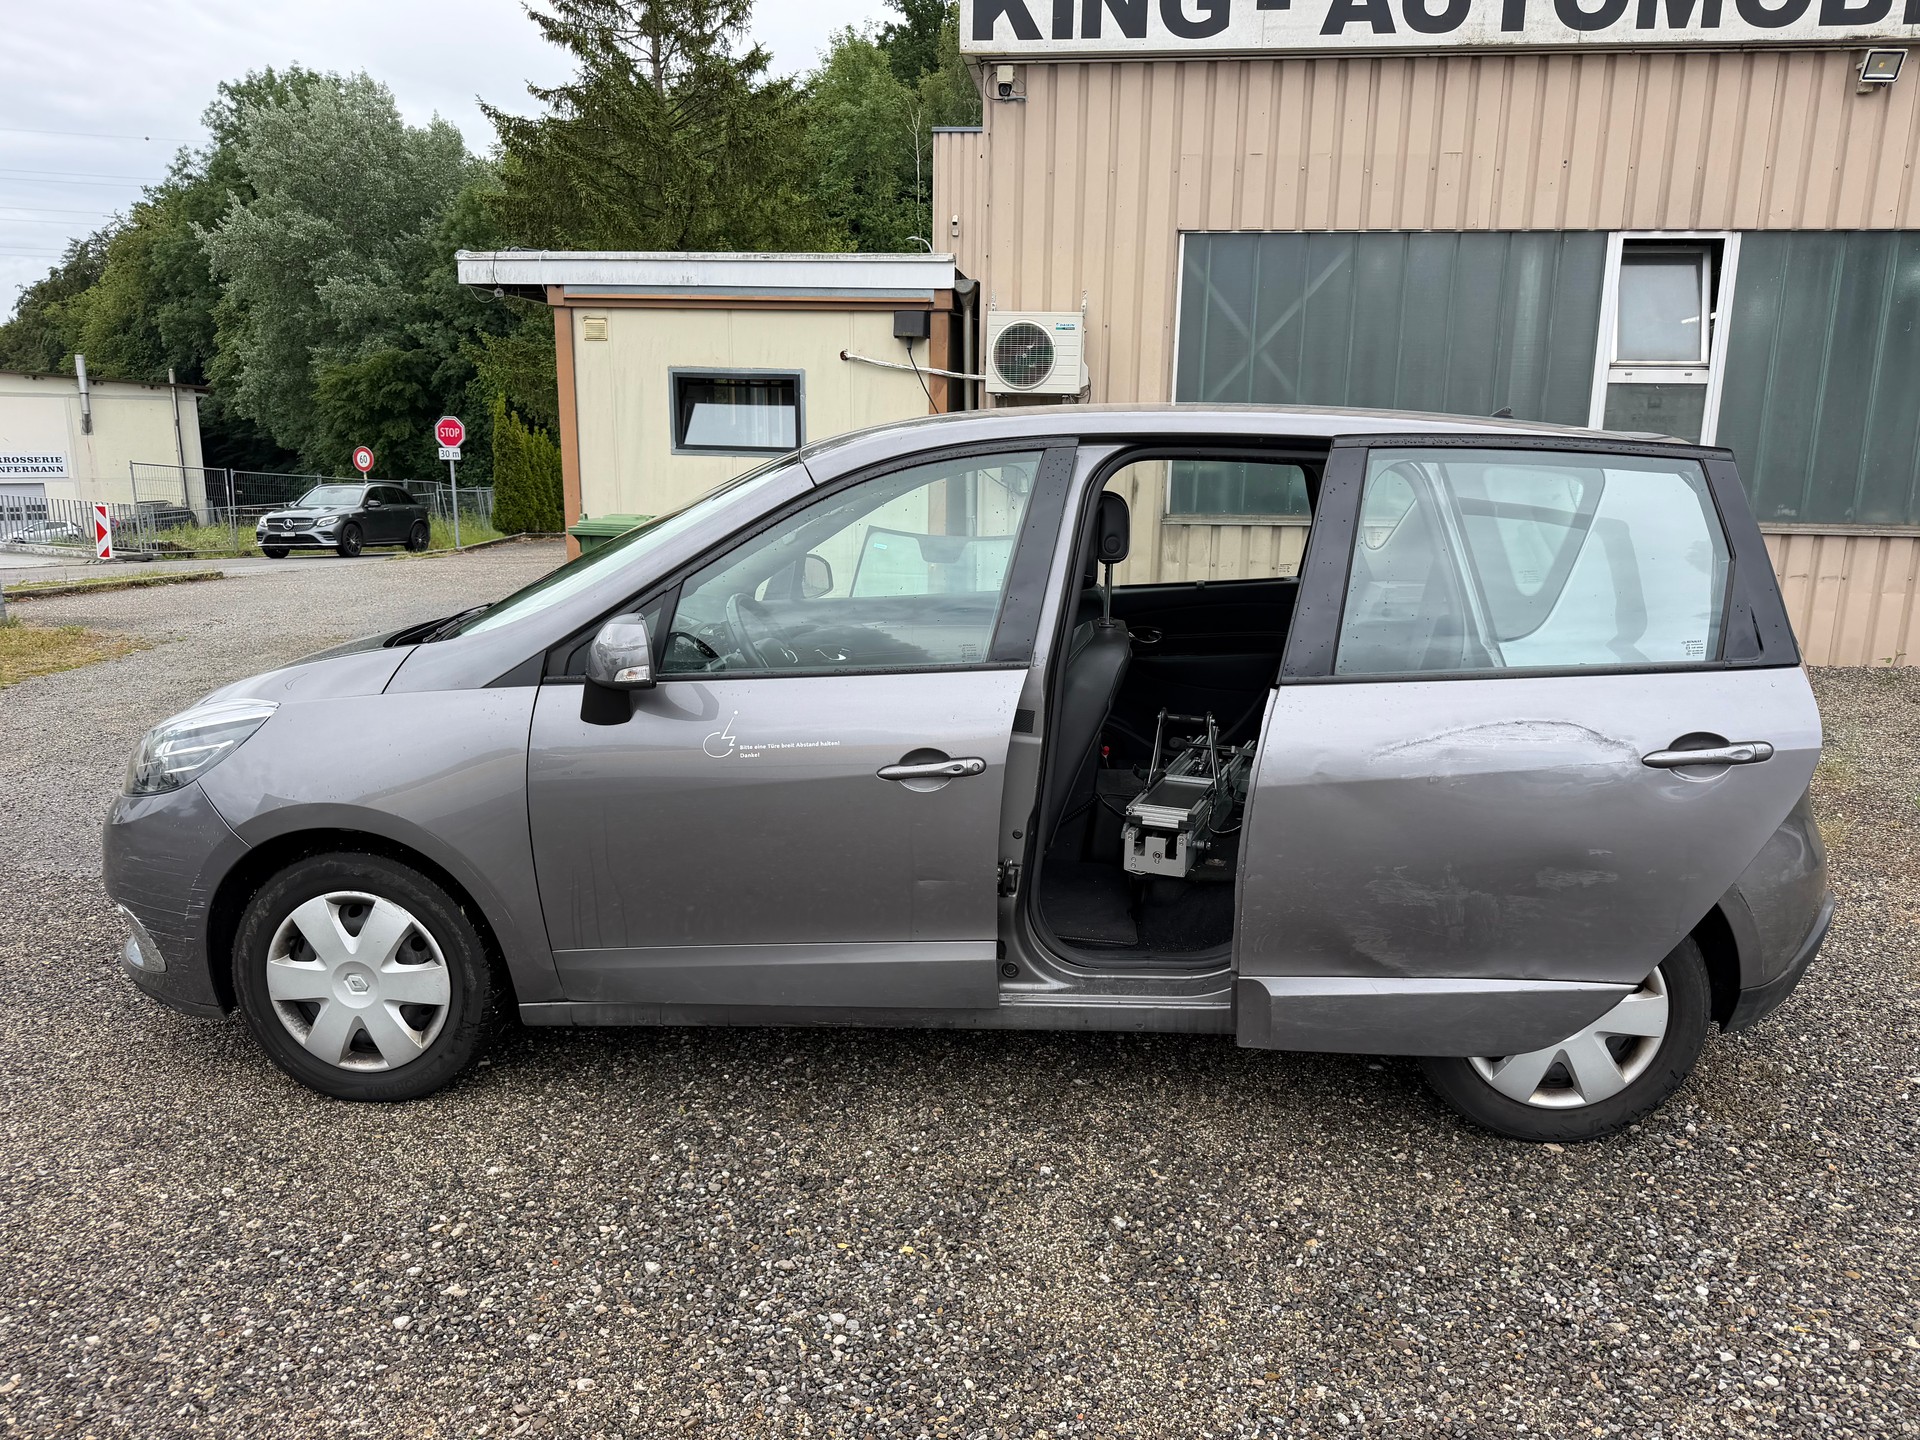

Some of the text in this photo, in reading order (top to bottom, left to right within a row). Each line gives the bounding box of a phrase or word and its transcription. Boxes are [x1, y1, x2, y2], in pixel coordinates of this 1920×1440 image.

[972, 0, 1231, 40] KING
[440, 427, 460, 437] STOP
[440, 449, 450, 457] 30
[360, 454, 368, 464] 60
